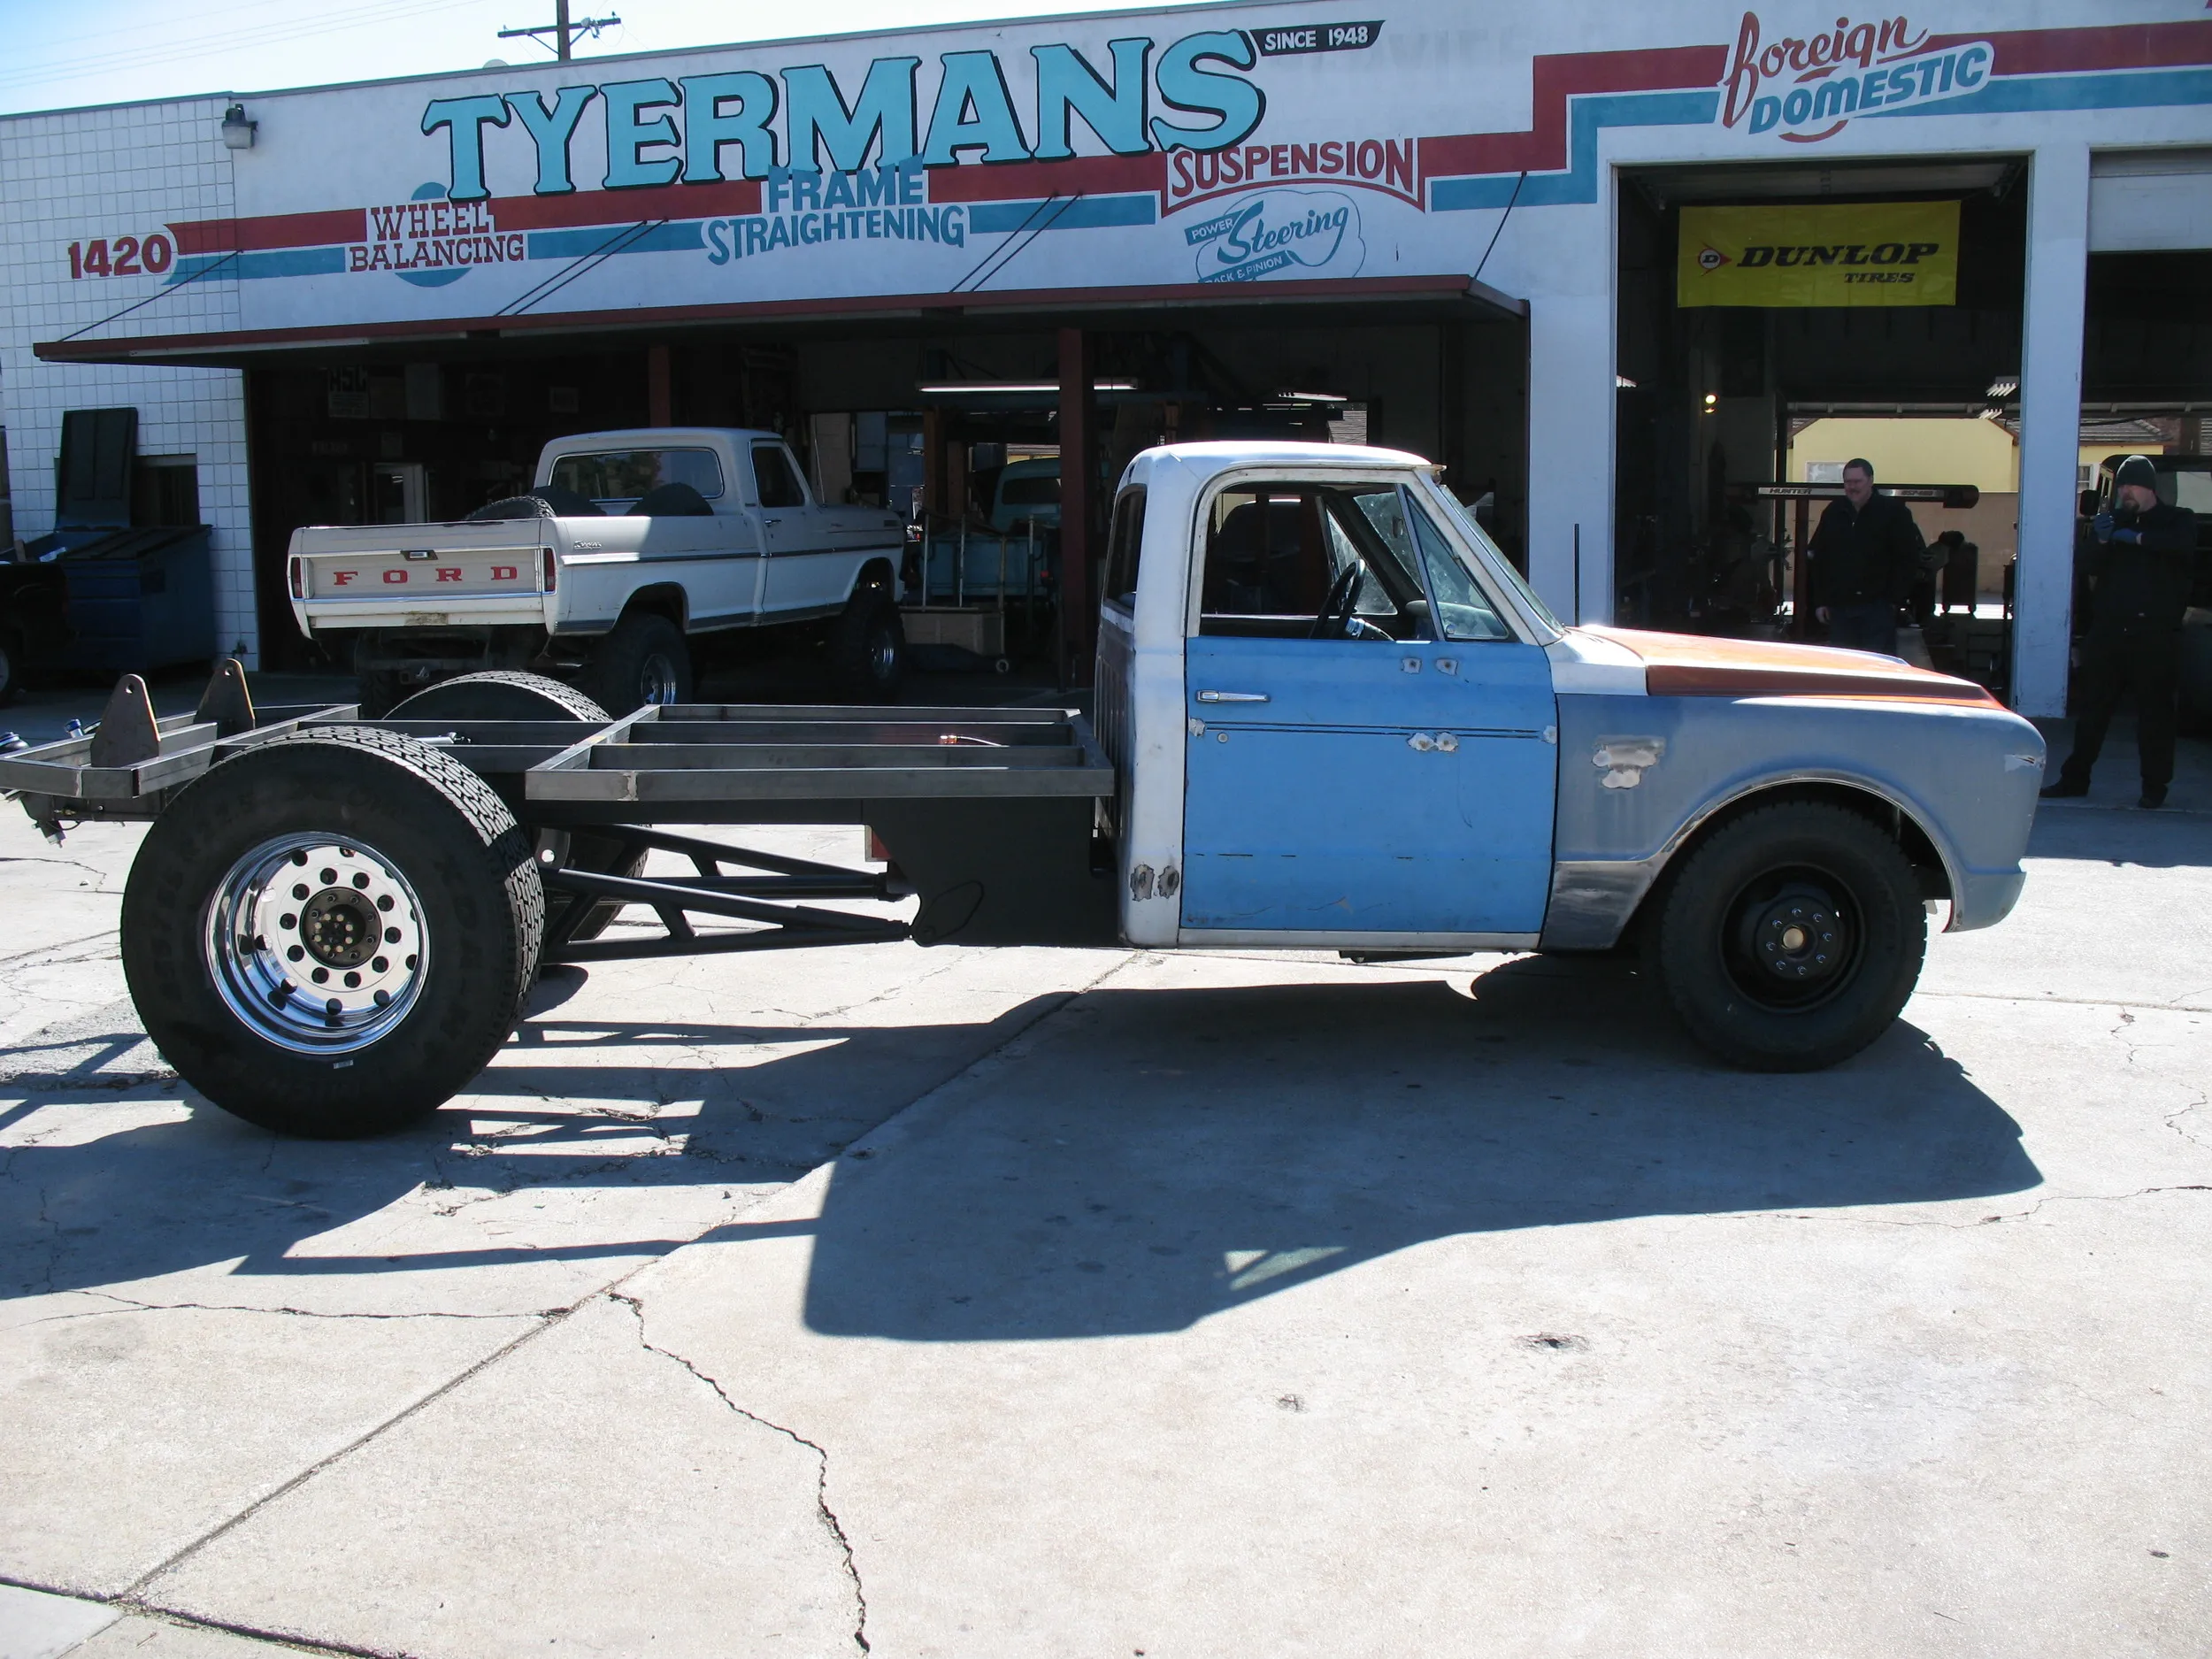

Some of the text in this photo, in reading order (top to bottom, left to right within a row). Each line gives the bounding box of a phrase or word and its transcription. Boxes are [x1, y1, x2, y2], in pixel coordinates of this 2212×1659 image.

[1264, 26, 1368, 51] SINCE 1948
[1723, 12, 1928, 128] foreign
[1748, 47, 1987, 134] DOMESTIC
[420, 29, 1265, 204] TYERMANS
[768, 151, 924, 213] FRAME
[1171, 138, 1413, 198] SUSPENSION
[371, 201, 494, 241] WHEEL
[708, 205, 964, 265] STRAIGHTENING
[1191, 218, 1233, 241] POWER
[1217, 200, 1349, 267] Steering
[67, 234, 172, 279] 1420
[349, 233, 525, 272] BALANCING
[1246, 256, 1283, 276] PINION
[1737, 242, 1939, 267] DUNLOP
[1844, 272, 1916, 283] TIRES
[334, 566, 517, 586] FORD
